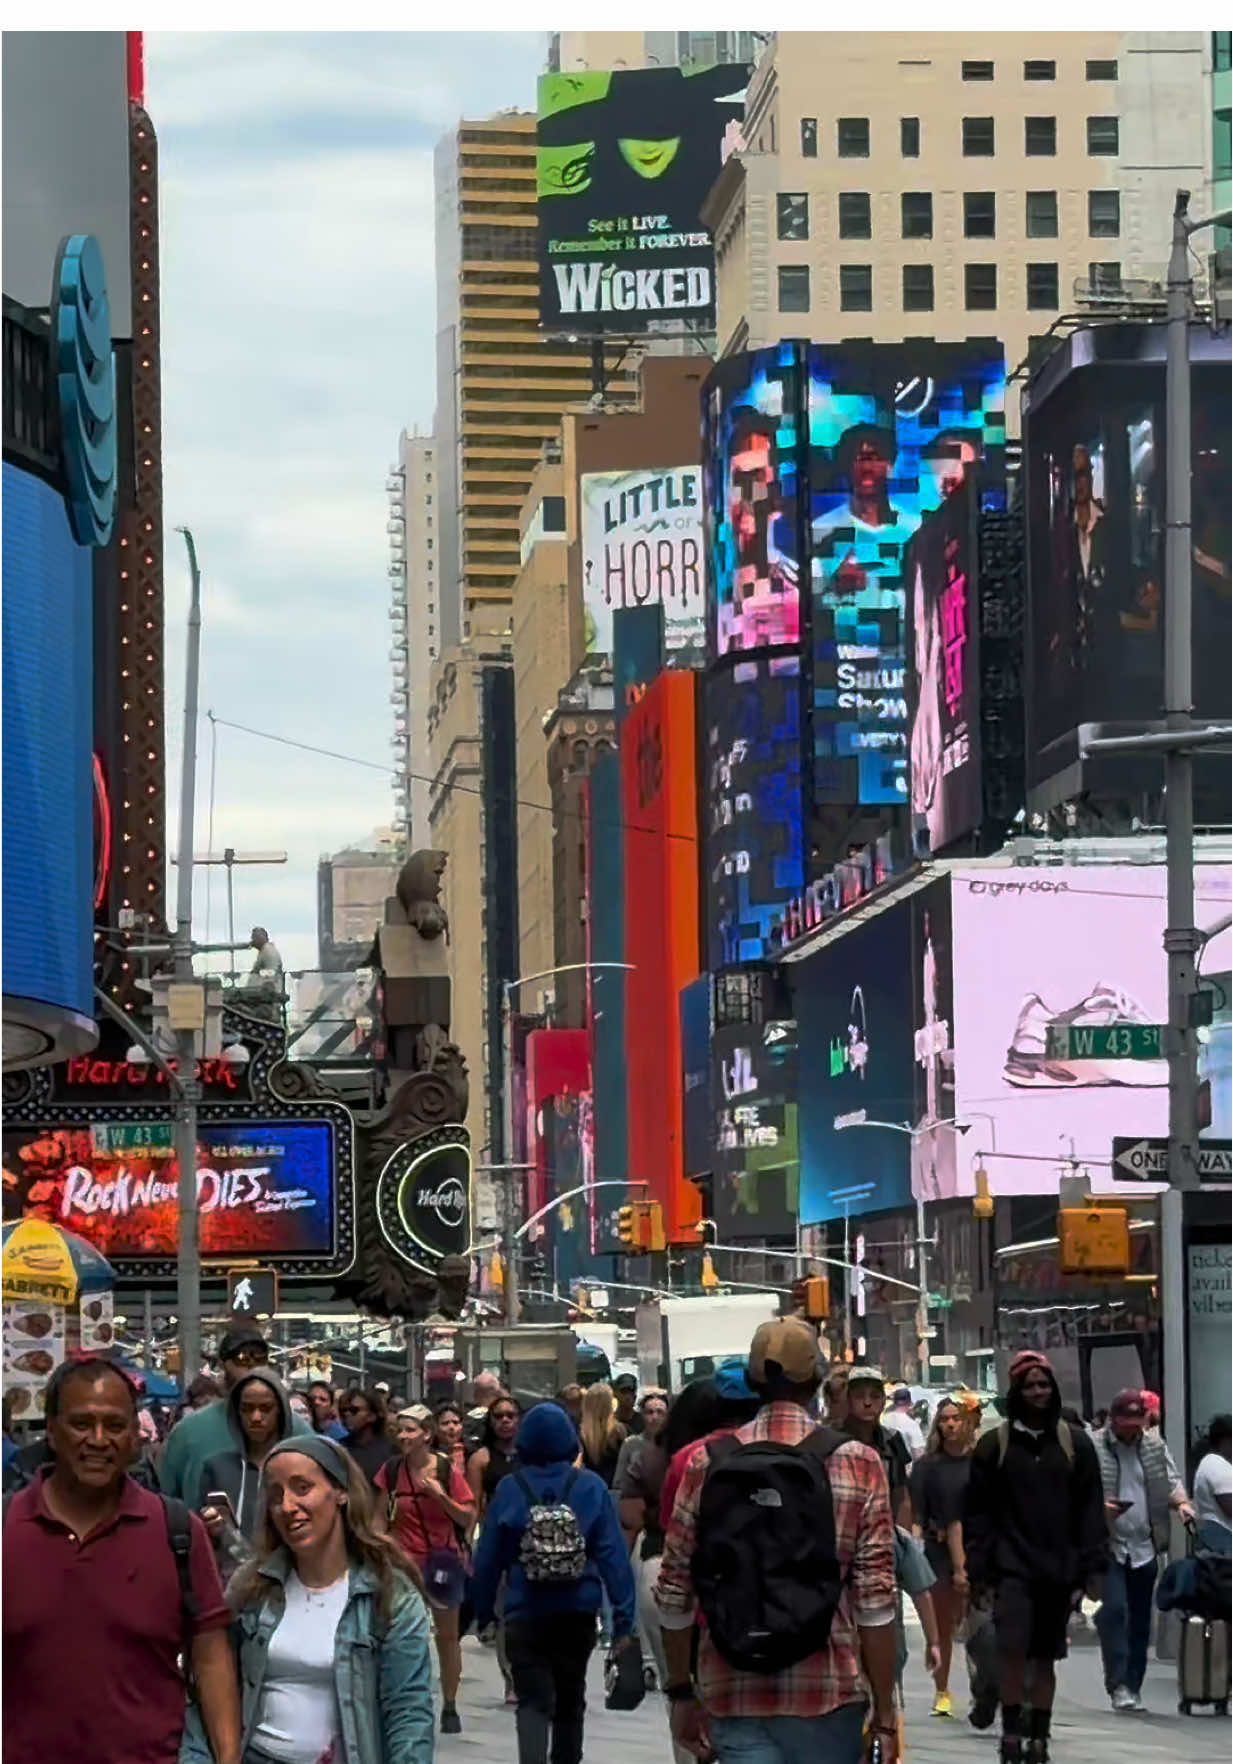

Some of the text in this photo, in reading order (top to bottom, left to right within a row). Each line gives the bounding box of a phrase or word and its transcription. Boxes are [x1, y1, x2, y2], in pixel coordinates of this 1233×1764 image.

[587, 218, 615, 232] See
[604, 475, 697, 535] LITTLE
[1075, 1027, 1158, 1056] W 43 St
[111, 1128, 125, 1145] W
[134, 1127, 152, 1145] 43
[195, 1167, 271, 1213] DIES
[416, 1188, 453, 1207] Hard
